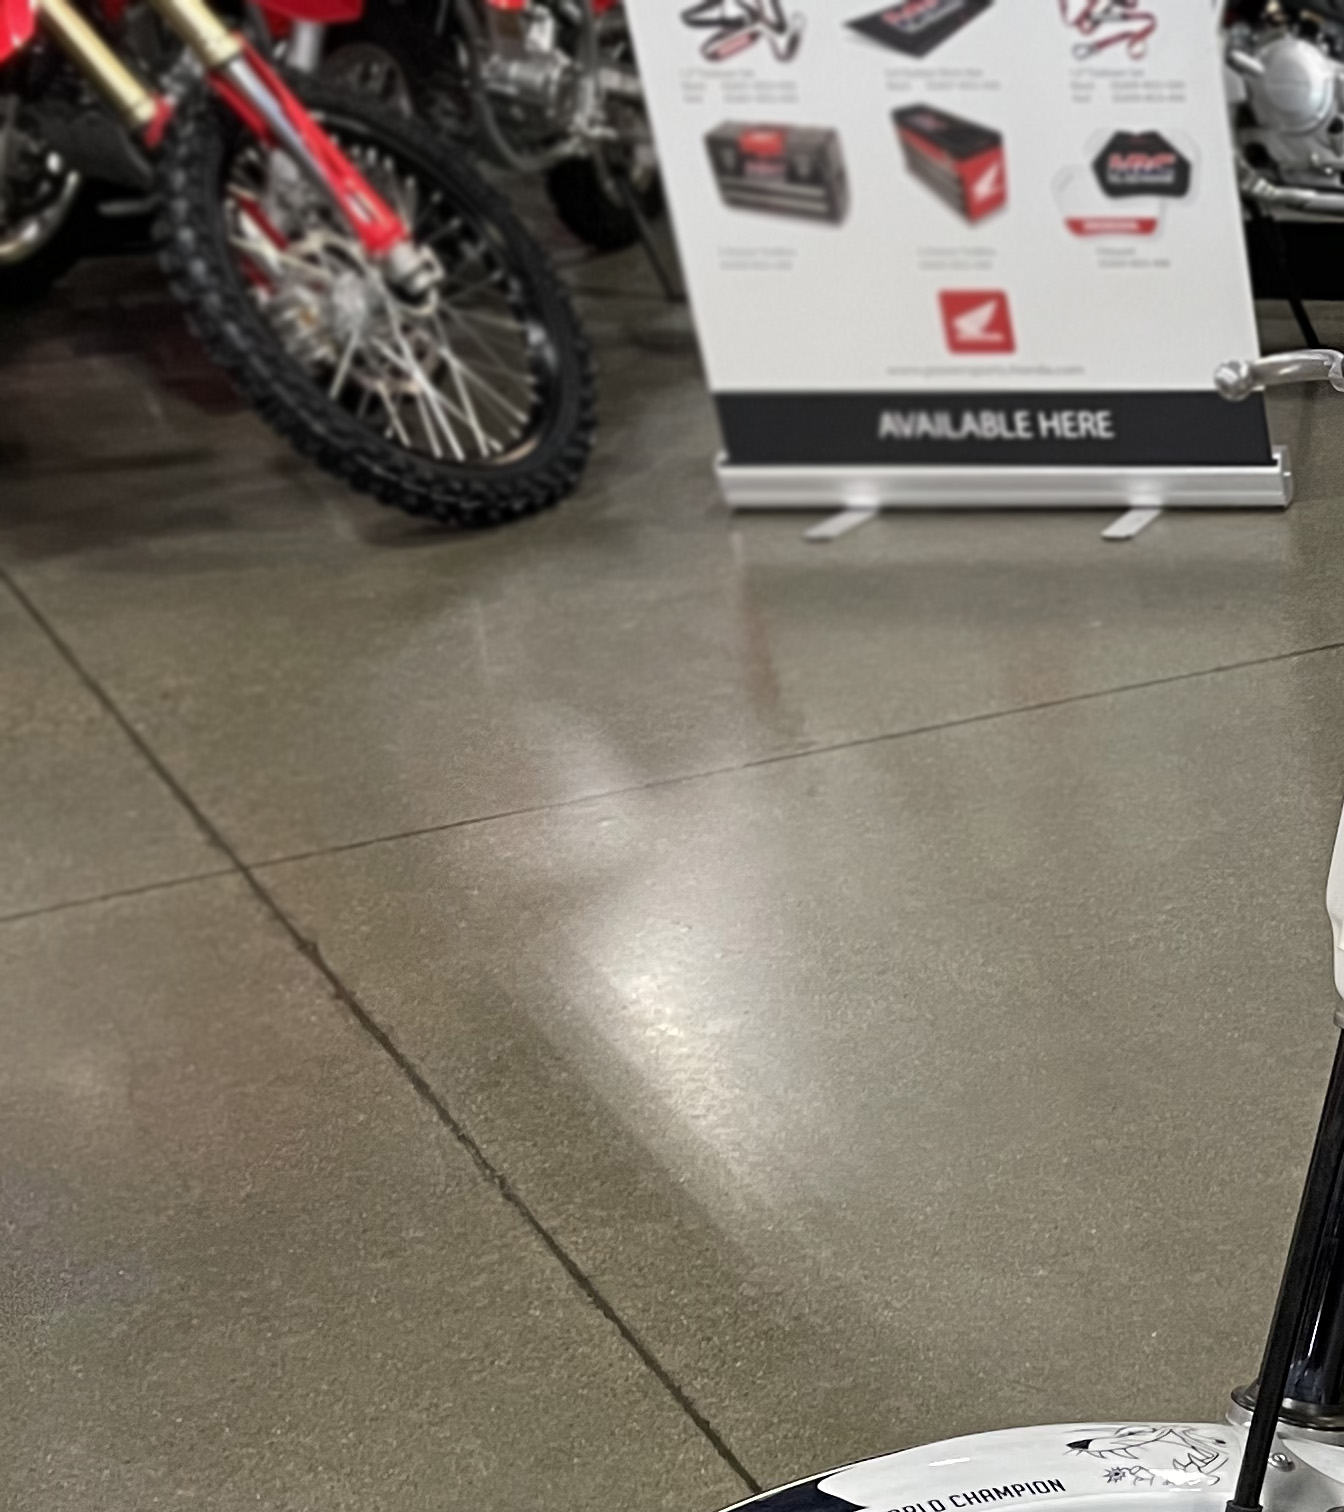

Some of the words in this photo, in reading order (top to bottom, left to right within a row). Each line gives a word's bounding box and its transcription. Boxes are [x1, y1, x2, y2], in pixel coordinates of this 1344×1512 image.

[878, 409, 1034, 440] AVAILABLE
[1037, 409, 1116, 440] HERE
[949, 1478, 1067, 1509] CHAMPION
